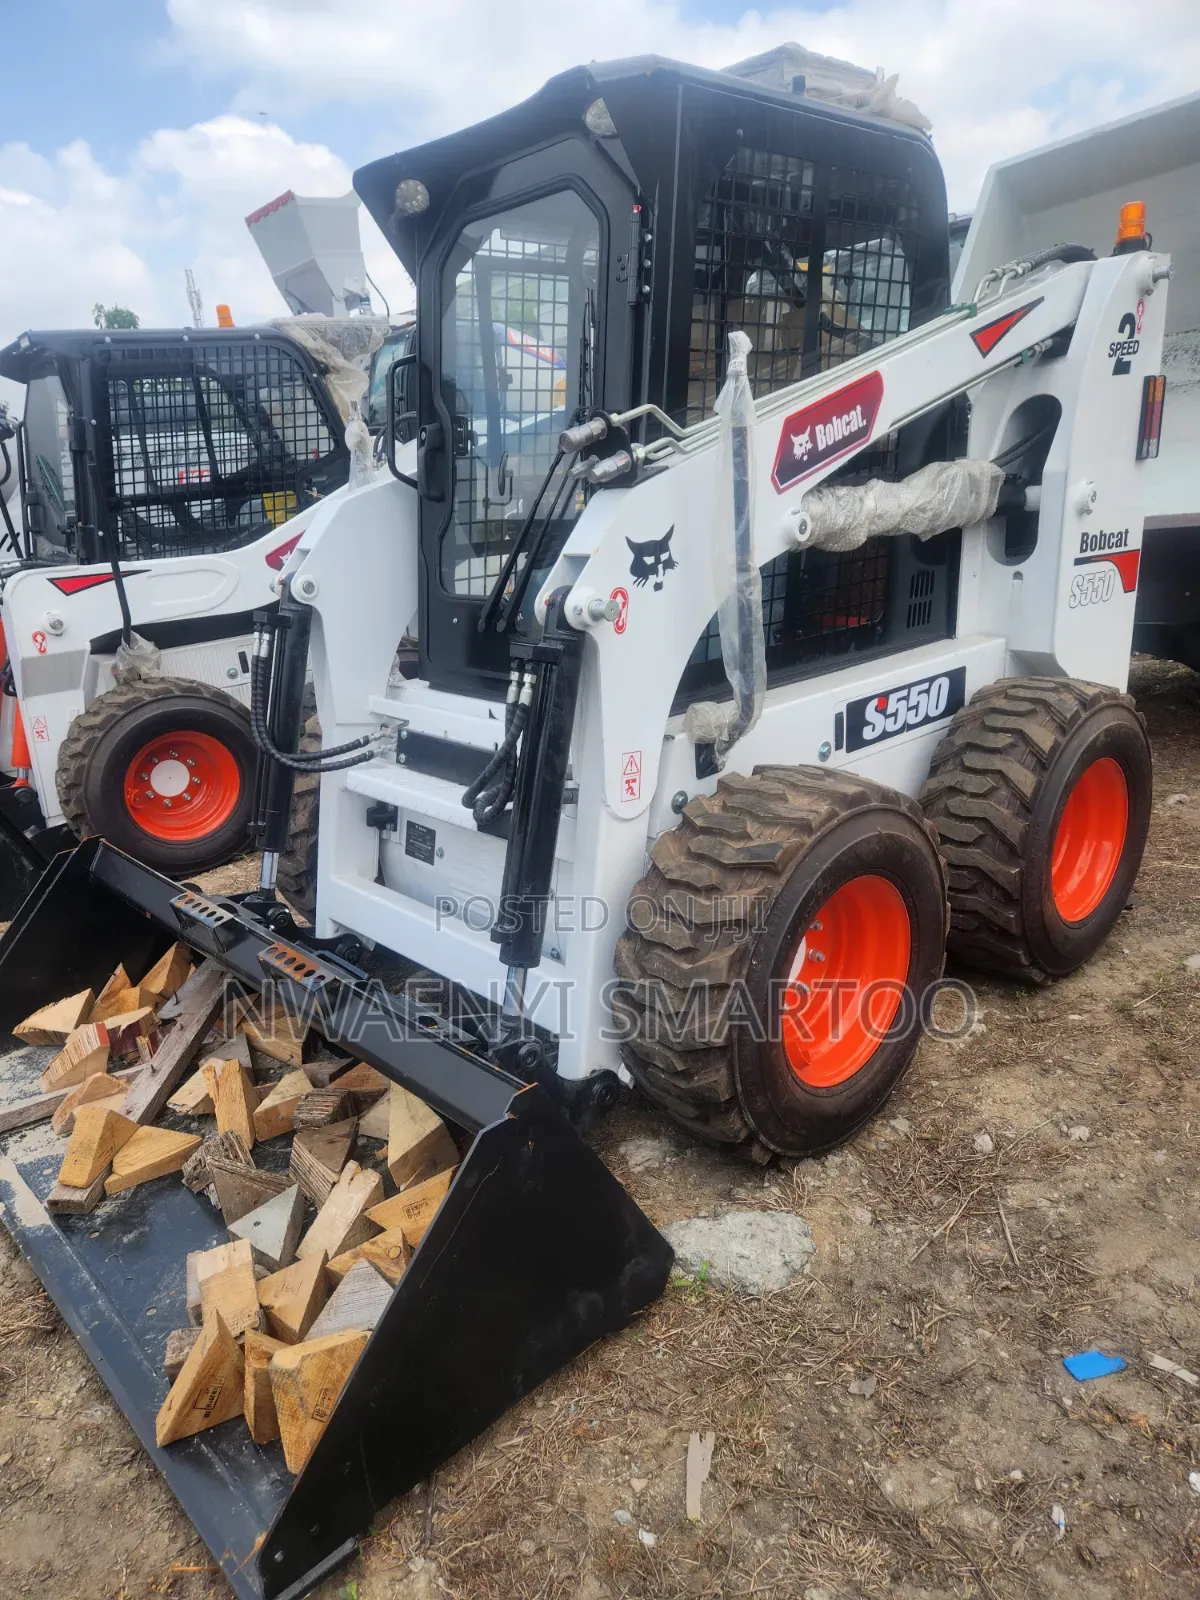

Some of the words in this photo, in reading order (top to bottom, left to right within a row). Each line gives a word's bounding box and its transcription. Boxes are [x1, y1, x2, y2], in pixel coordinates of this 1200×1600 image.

[1108, 340, 1140, 358] SPEED
[1112, 312, 1136, 376] 2
[1080, 528, 1129, 554] Bobcat
[1069, 568, 1116, 609] S550
[862, 676, 950, 741] S550
